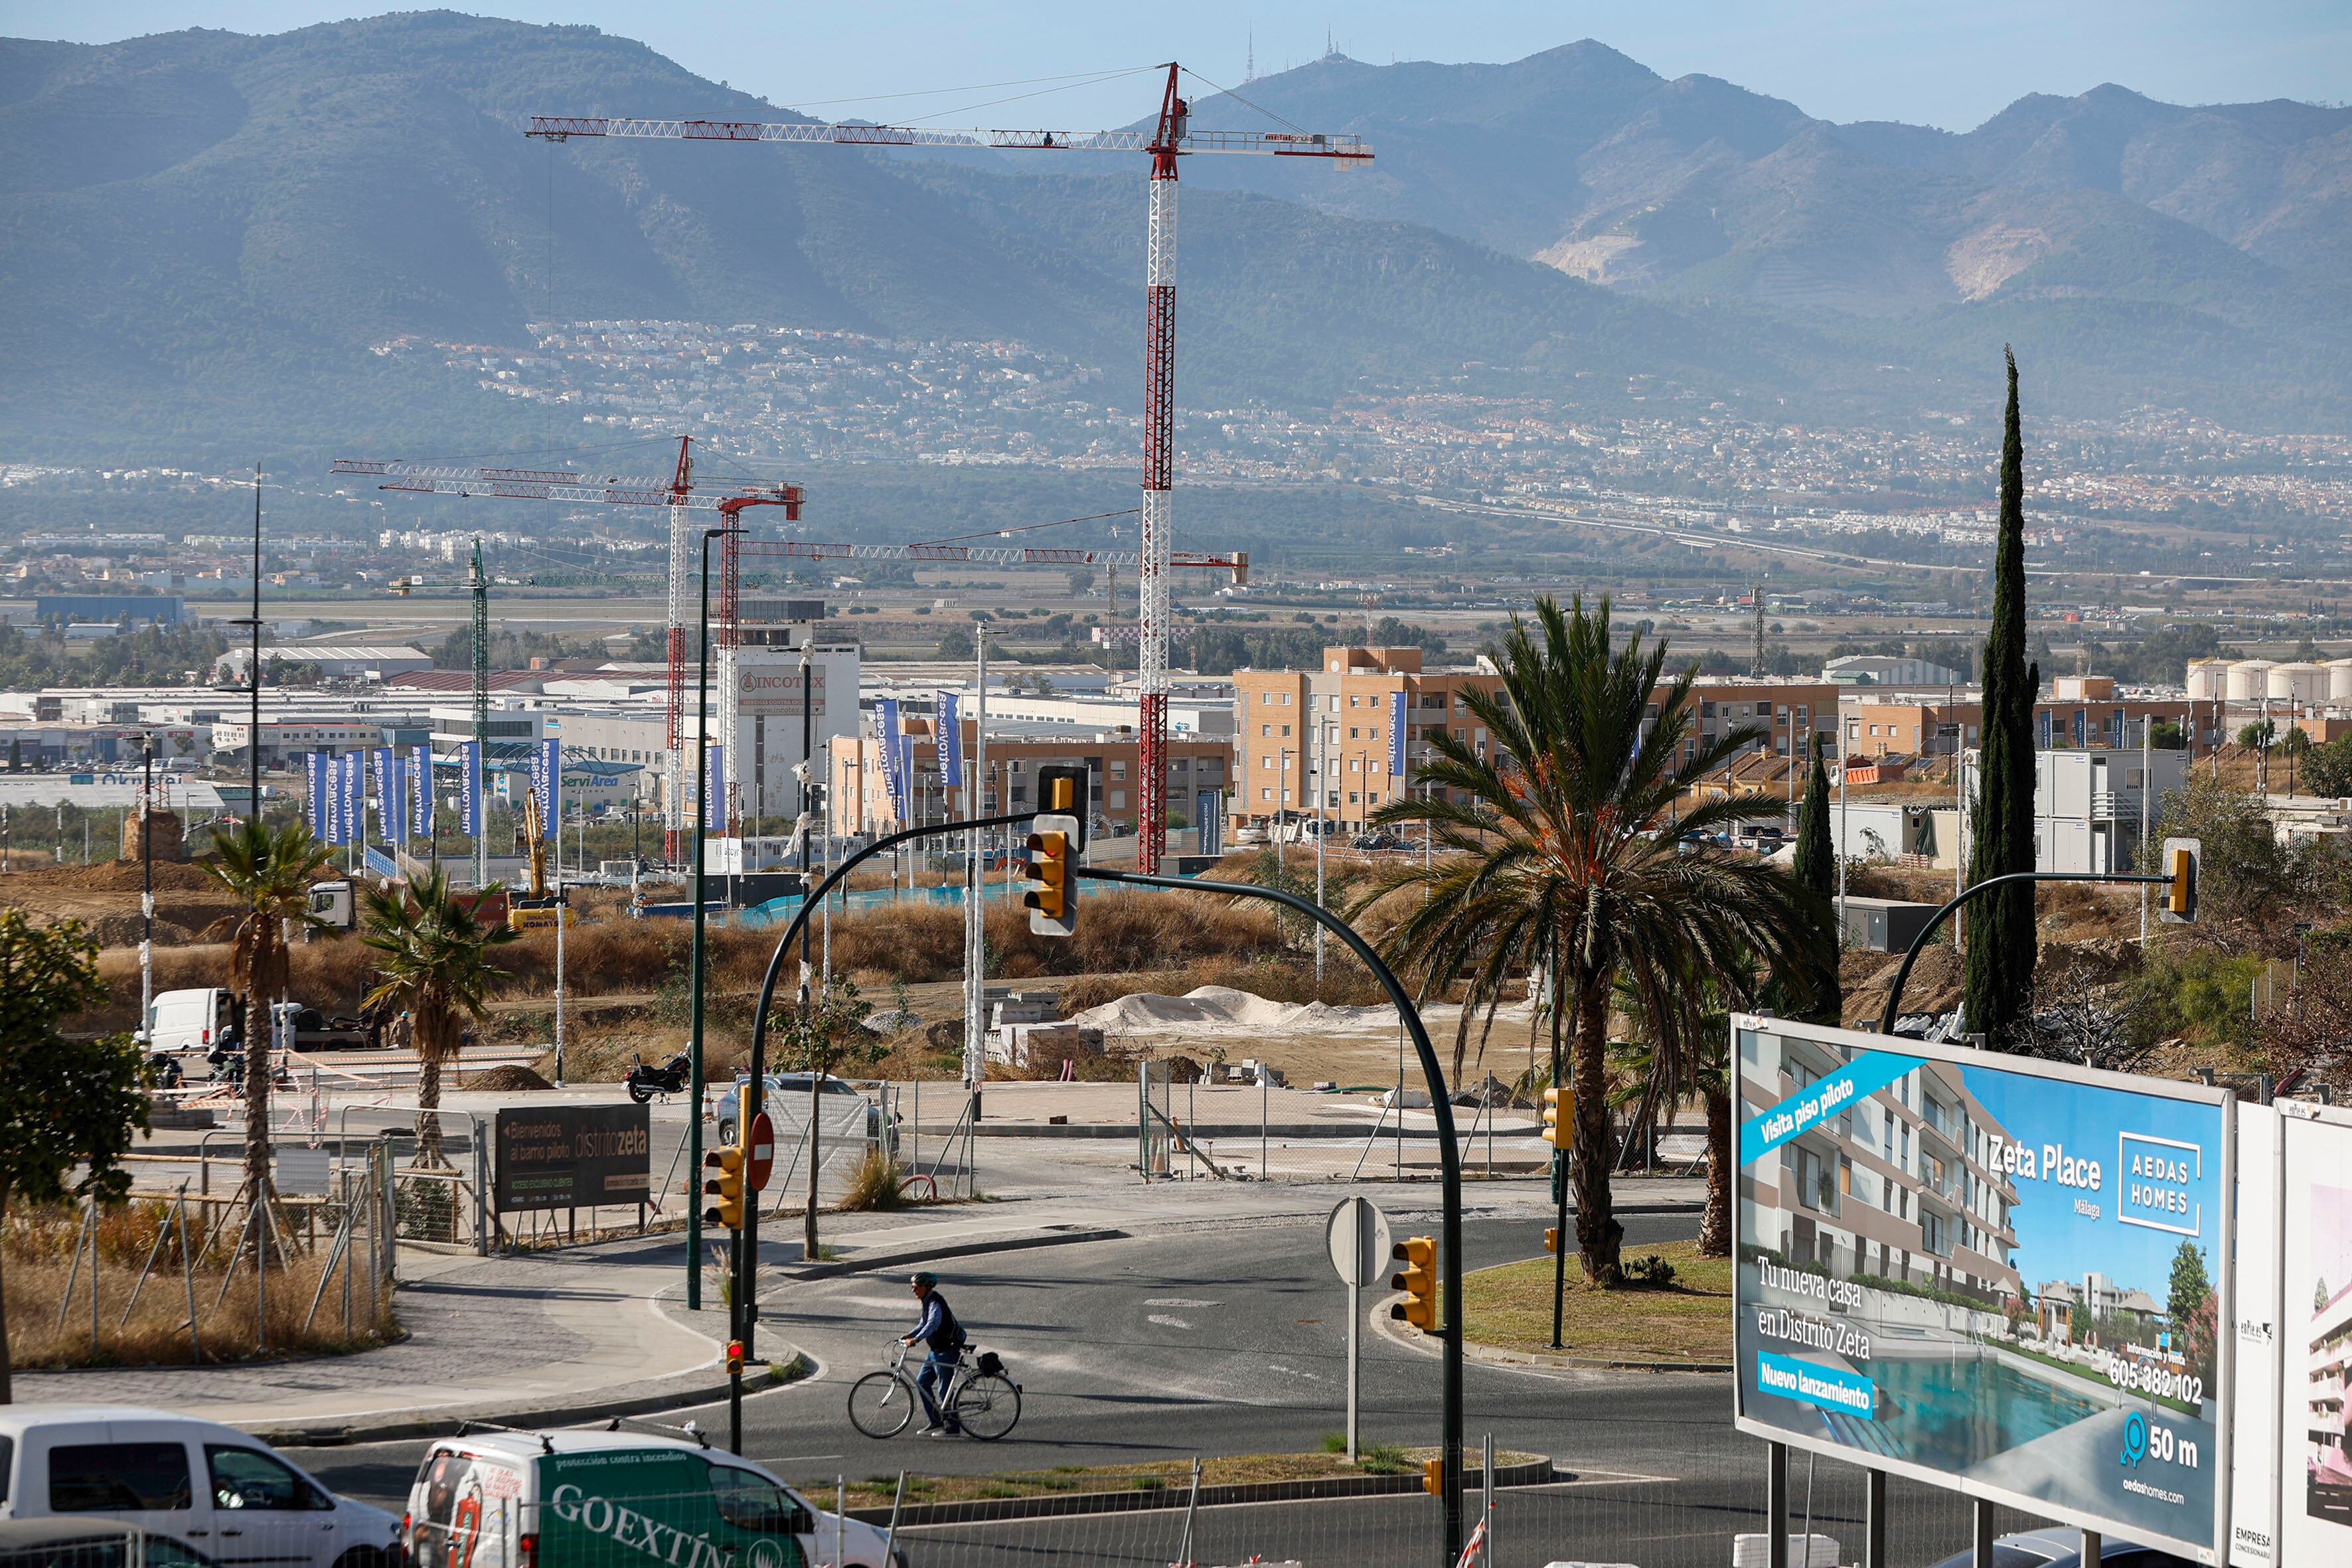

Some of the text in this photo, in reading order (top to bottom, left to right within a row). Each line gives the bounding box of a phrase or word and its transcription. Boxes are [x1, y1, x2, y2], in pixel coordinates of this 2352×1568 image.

[757, 676, 824, 688] INCOTX
[561, 775, 619, 787] ServiArea
[1761, 1077, 1853, 1144] Visita piso piloto
[510, 1121, 561, 1138] Bienvenidos
[576, 1125, 647, 1158] distritozeta
[510, 1142, 570, 1162] al barrio piloto
[1990, 1134, 2101, 1191] Zeta Place
[2132, 1154, 2188, 1184] AEDAS
[2074, 1198, 2100, 1220] Málaga
[2132, 1183, 2188, 1214] HOMES
[1758, 1256, 1861, 1308] Tu nueva casa
[1759, 1310, 1870, 1360] en Distrito Zeta
[2127, 1342, 2185, 1366] Información y venta
[1762, 1362, 1869, 1410] Nuevo lanzamiento
[2110, 1358, 2203, 1405] 605 382 102
[555, 1450, 687, 1472] protección contra incendios
[2150, 1425, 2198, 1468] 50 m
[2123, 1478, 2184, 1505] aedashomes.com
